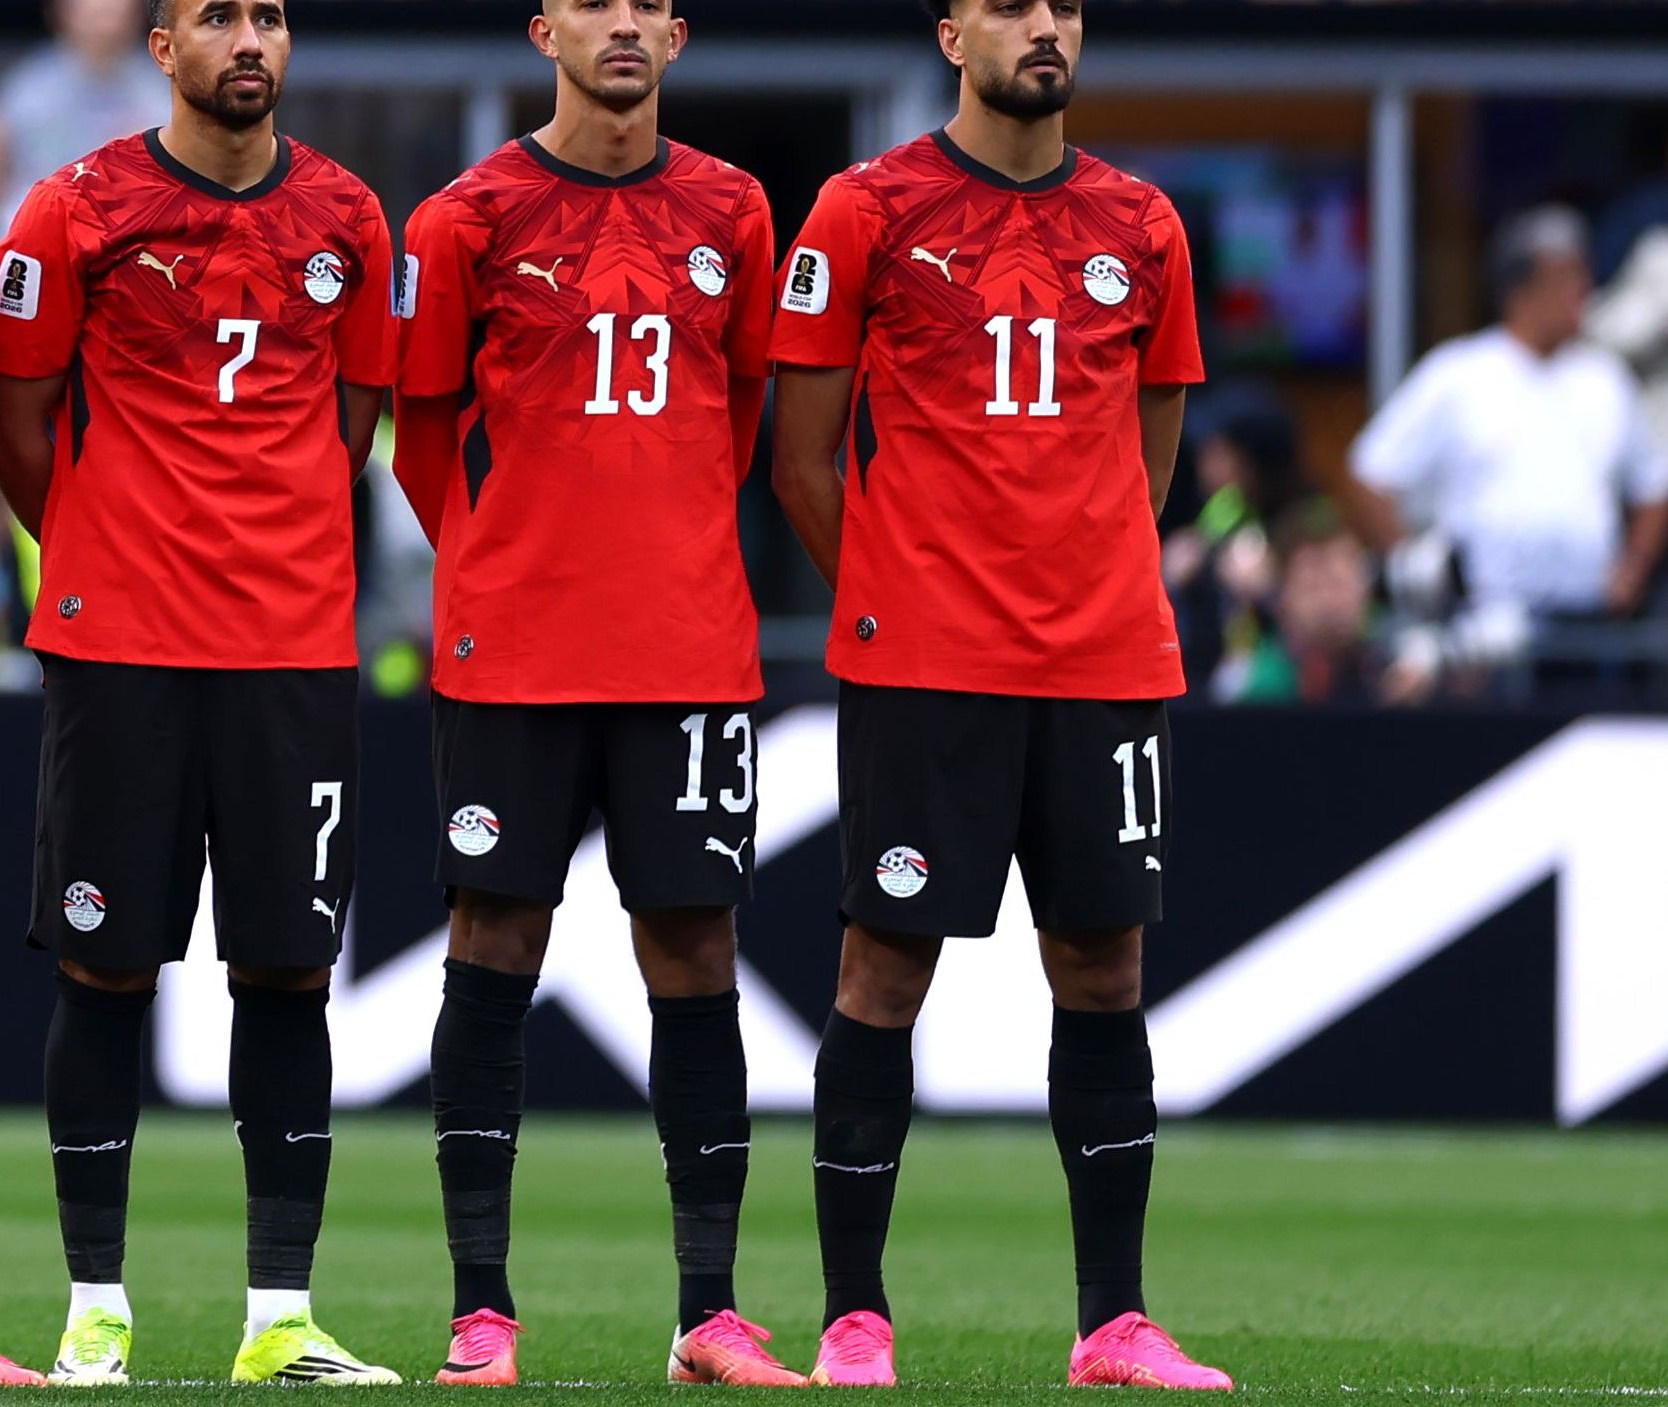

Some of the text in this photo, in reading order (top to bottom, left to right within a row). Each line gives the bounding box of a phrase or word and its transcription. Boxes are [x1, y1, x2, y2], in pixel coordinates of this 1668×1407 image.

[0, 301, 23, 313] 2026
[787, 298, 811, 308] 2026
[216, 318, 262, 403] 7
[584, 313, 671, 416] 13
[983, 315, 1061, 417] 11
[675, 712, 753, 813] 13
[1112, 735, 1161, 843] 11
[310, 781, 343, 881] 7
